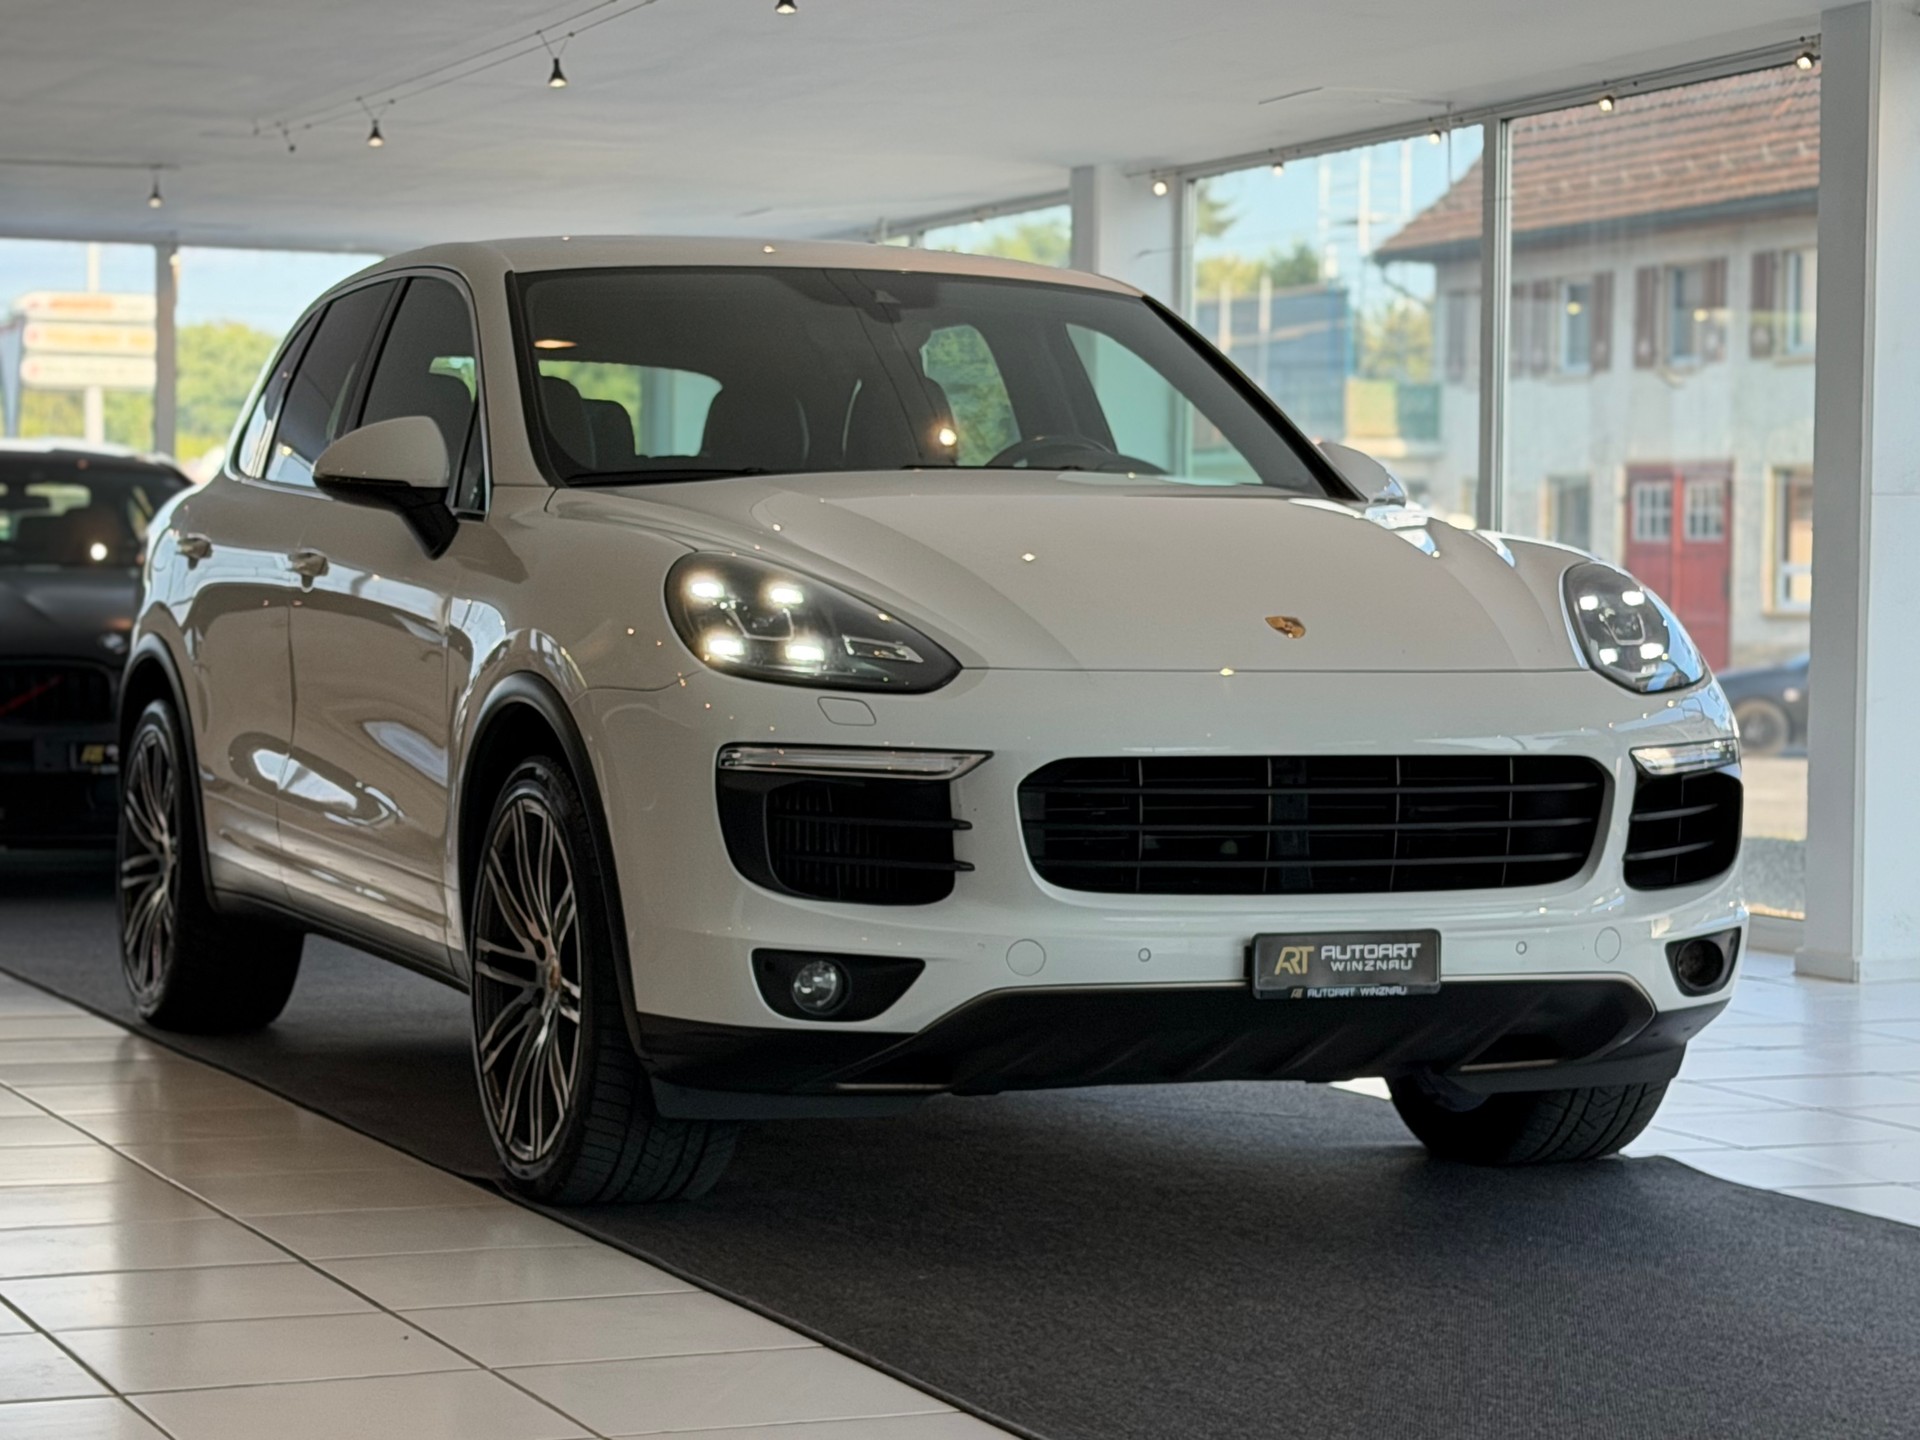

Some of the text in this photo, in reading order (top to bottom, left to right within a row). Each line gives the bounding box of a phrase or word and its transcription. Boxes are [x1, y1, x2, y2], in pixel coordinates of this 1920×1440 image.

[1320, 943, 1422, 960] AUTOART
[1330, 959, 1413, 972] WINZNAU
[1307, 987, 1356, 998] AUTOART
[1360, 986, 1408, 997] WINZNAU
